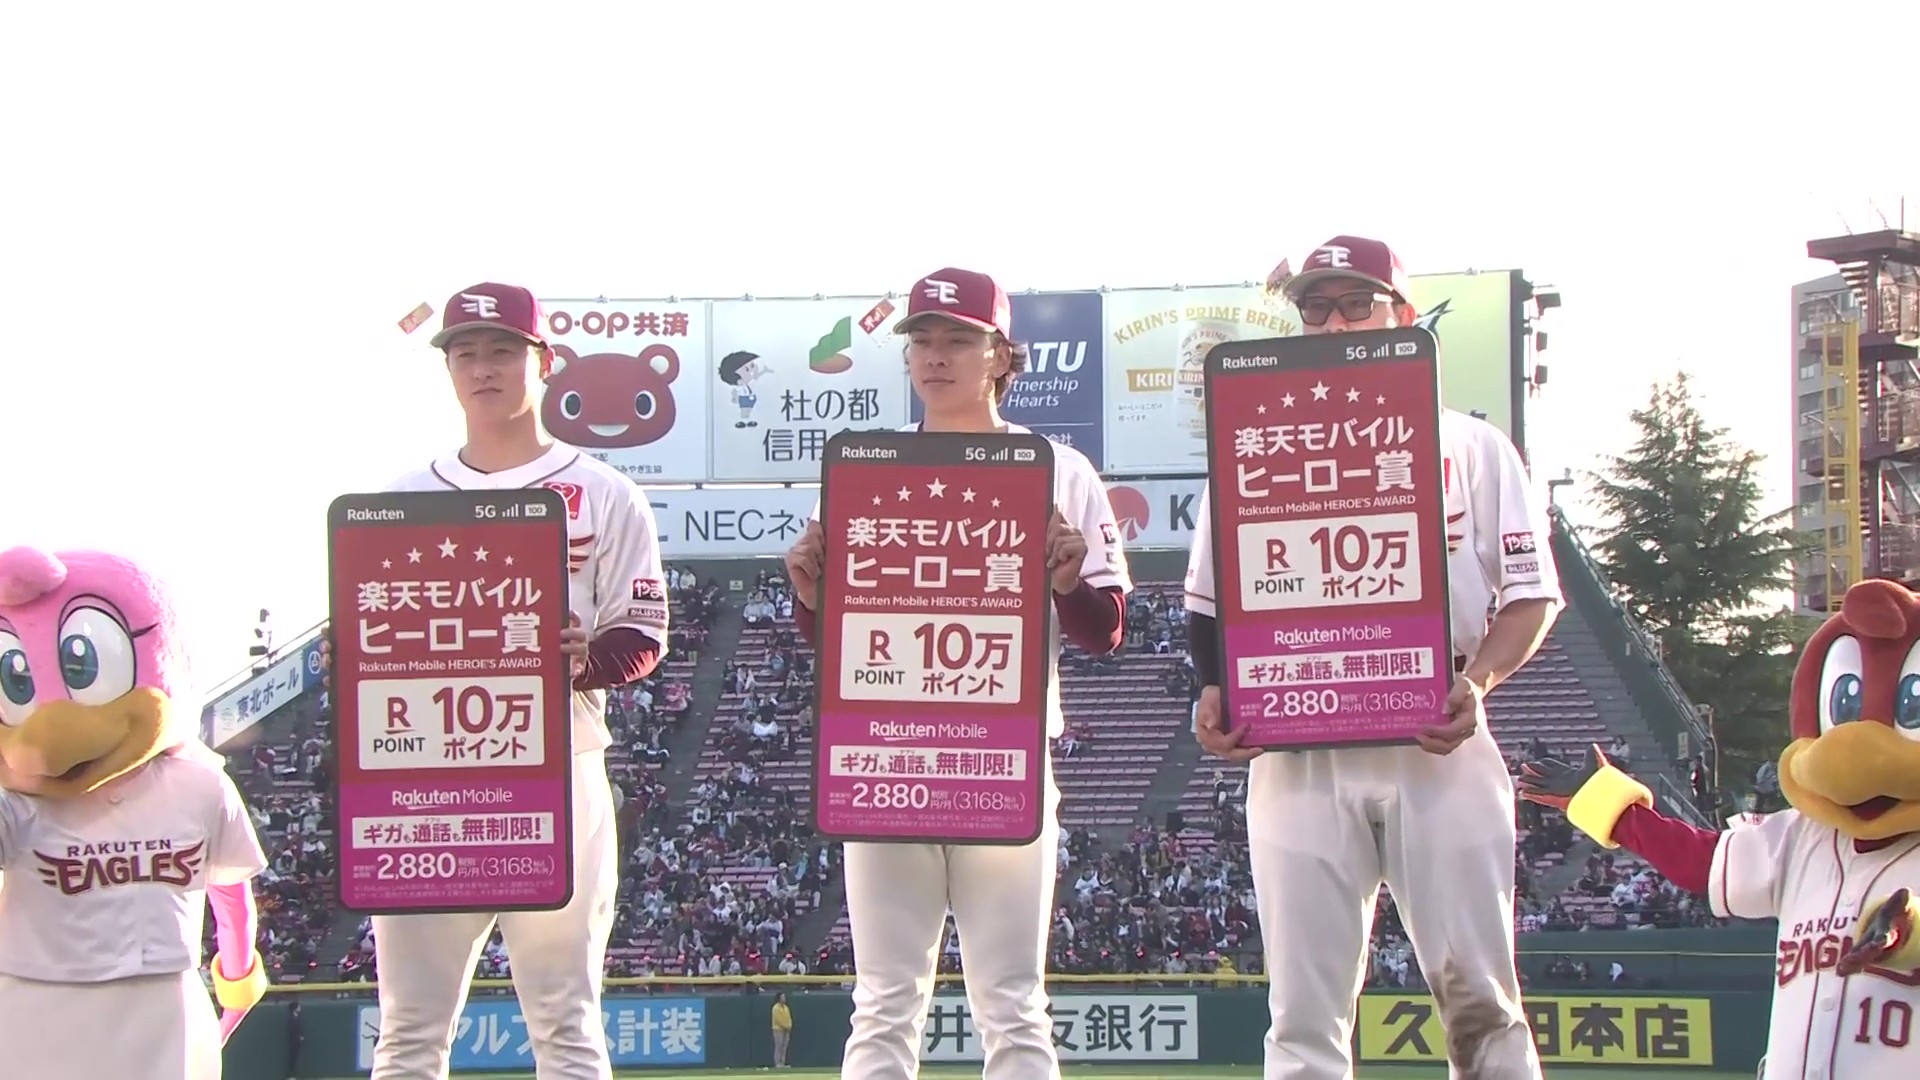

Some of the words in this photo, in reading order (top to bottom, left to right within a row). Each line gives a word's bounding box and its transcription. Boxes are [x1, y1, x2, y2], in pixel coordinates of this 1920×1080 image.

[633, 312, 689, 336] 共済
[1186, 306, 1241, 321] PRIME
[1223, 356, 1278, 370] Rakuten
[1346, 347, 1367, 360] 5G
[1012, 376, 1079, 393] tnership
[1136, 373, 1172, 387] KIRI
[781, 389, 879, 422] 杜の都
[1007, 394, 1060, 408] Hearts
[1234, 415, 1414, 458] 楽天モバイル
[842, 446, 897, 459] Rakuten
[965, 447, 986, 461] 5G
[1237, 450, 1415, 498] ヒーロー賞
[347, 508, 404, 520] Rakuten
[474, 506, 496, 519] 5G
[1170, 493, 1196, 531] K
[1238, 505, 1283, 516] Rakuten
[1285, 502, 1322, 513] Mobile
[1324, 499, 1371, 511] HEROE'S
[1373, 495, 1416, 507] AWARD
[846, 517, 1026, 548] 楽天モバイル
[1309, 525, 1409, 574] 10万
[846, 553, 1023, 594] ヒーロー賞
[357, 577, 542, 612] 楽天モバイル
[1254, 577, 1305, 595] POINT
[1322, 574, 1404, 599] ポイント
[844, 595, 891, 606] Rakuten
[892, 596, 929, 606] Mobile
[931, 596, 978, 607] HEROE'S
[979, 598, 1023, 608] AWARD
[359, 612, 541, 654] ヒーロー賞
[1274, 629, 1340, 645] Rakuten
[1342, 625, 1392, 641] Mobile
[914, 622, 1013, 671] 10万
[359, 661, 407, 672] Rakuten
[409, 660, 446, 671] Mobile
[448, 659, 496, 670] HEROE'S
[498, 657, 542, 668] AWARD
[854, 669, 905, 685] POINT
[922, 671, 1004, 696] ポイント
[237, 667, 299, 722] 東北ボール
[1263, 689, 1339, 718] 2,880
[432, 685, 534, 734] 10万
[870, 721, 936, 738] Rakuten
[938, 723, 988, 739] Mobile
[373, 737, 426, 753] POINT
[443, 736, 527, 760] ポイント
[392, 789, 461, 806] Rakuten
[462, 788, 513, 804] Mobile
[852, 782, 929, 809] 2,880
[67, 839, 172, 857] RAKUTEN
[33, 840, 204, 895] EAGLES
[377, 852, 456, 880] 2,880
[1793, 917, 1858, 937] RAKU
[926, 1003, 1187, 1053] 井友銀行
[1855, 997, 1912, 1047] 10
